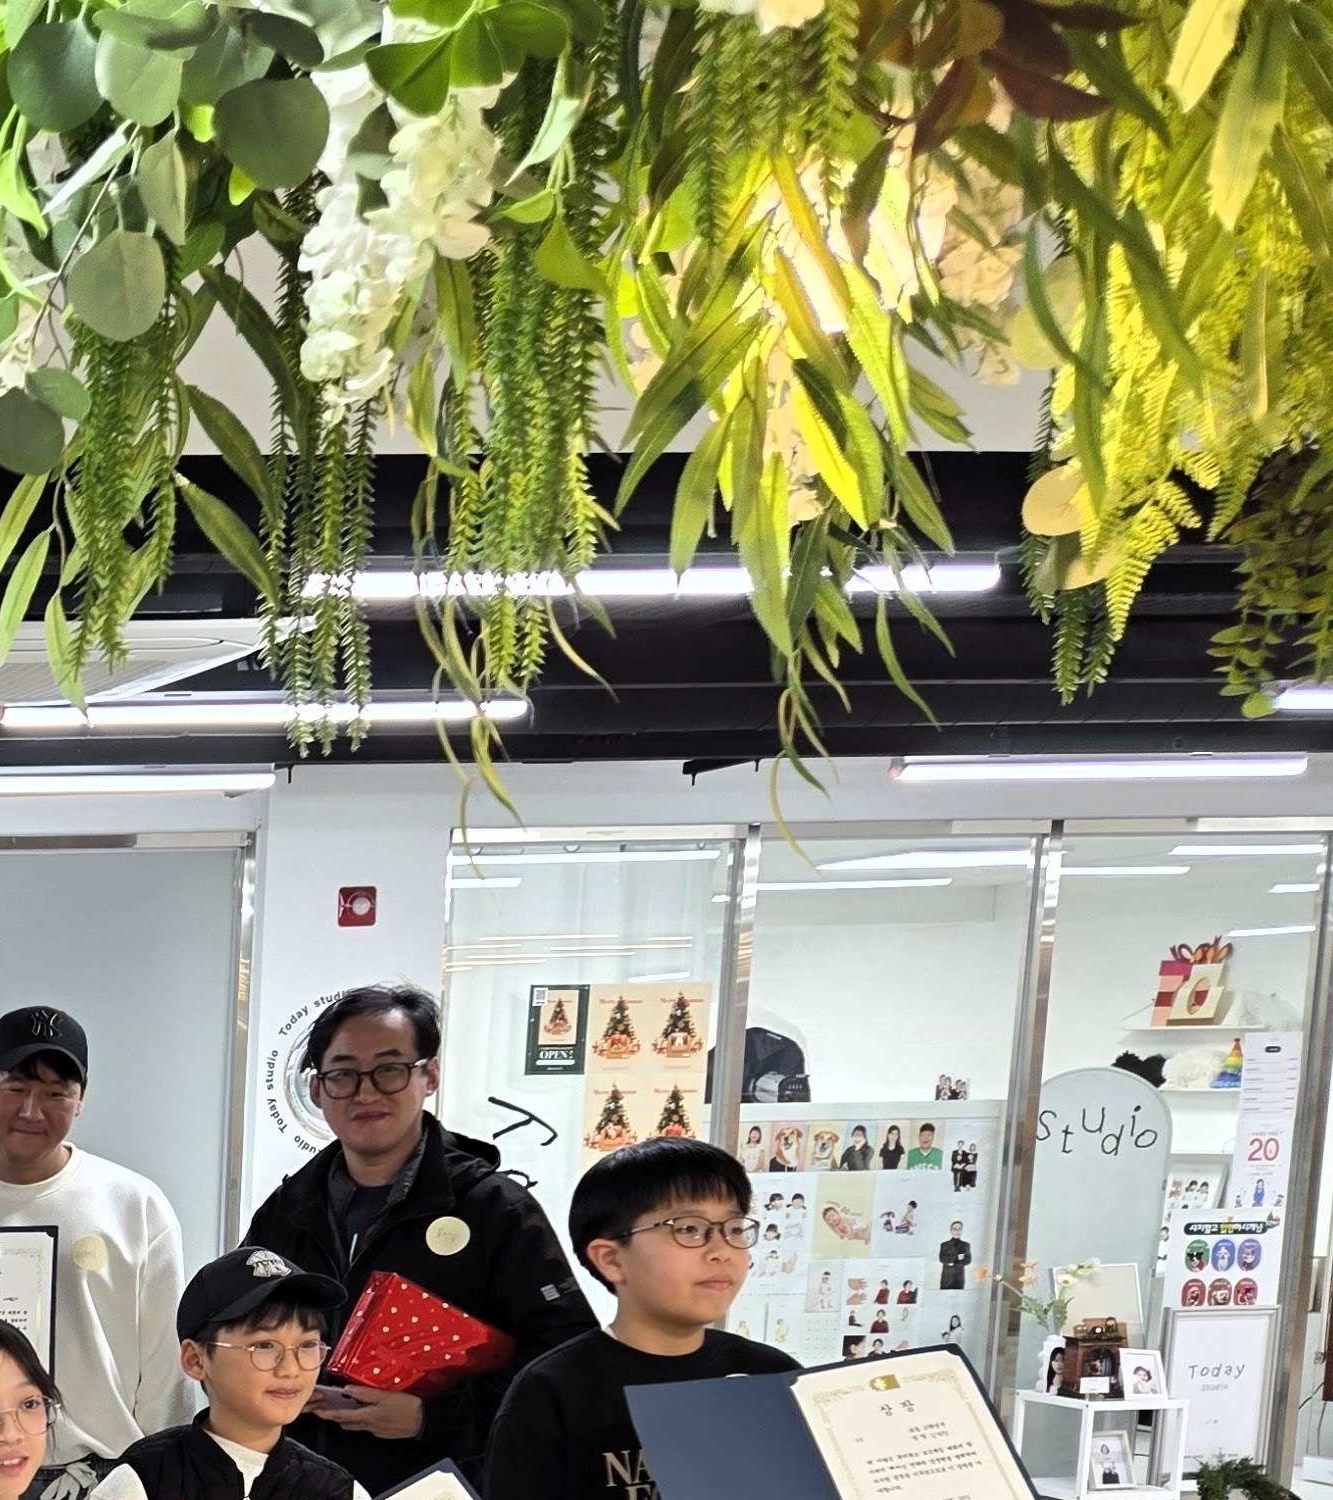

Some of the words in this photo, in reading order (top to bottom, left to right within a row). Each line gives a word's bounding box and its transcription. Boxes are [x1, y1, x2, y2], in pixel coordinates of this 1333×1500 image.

[278, 1005, 309, 1037] Today
[313, 990, 347, 1008] studi
[266, 1049, 279, 1091] studio
[267, 1098, 288, 1133] Today
[294, 1135, 322, 1154] udio
[1248, 1138, 1279, 1161] 20
[1189, 1363, 1245, 1379] Today
